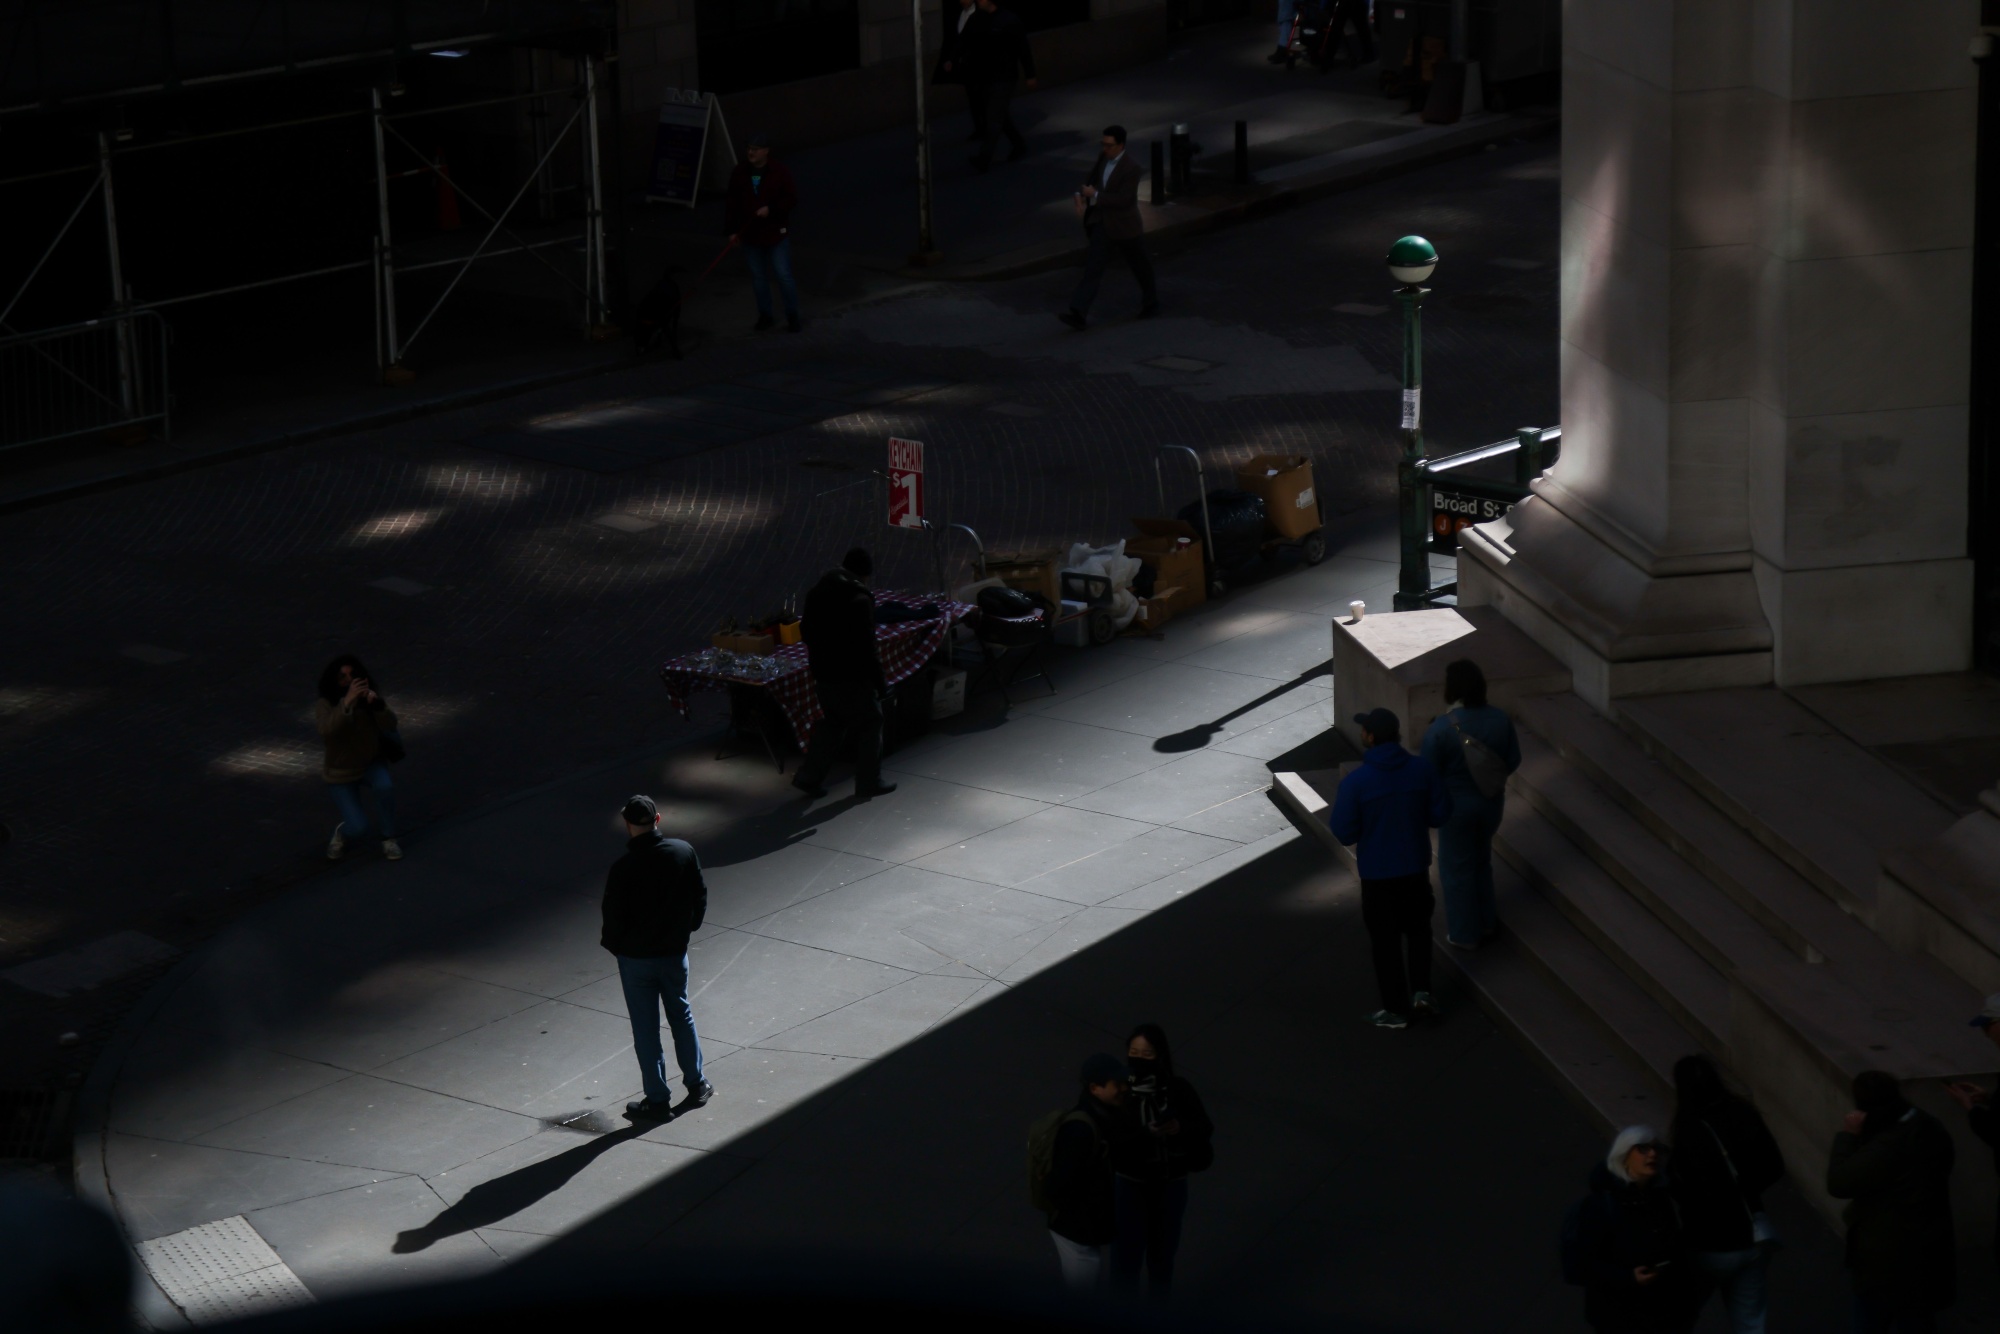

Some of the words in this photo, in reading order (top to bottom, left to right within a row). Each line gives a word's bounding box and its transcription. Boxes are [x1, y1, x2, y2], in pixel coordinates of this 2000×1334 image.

[889, 439, 922, 472] KEYCHAIN
[1434, 492, 1478, 515] Broad
[1439, 519, 1447, 531] J
